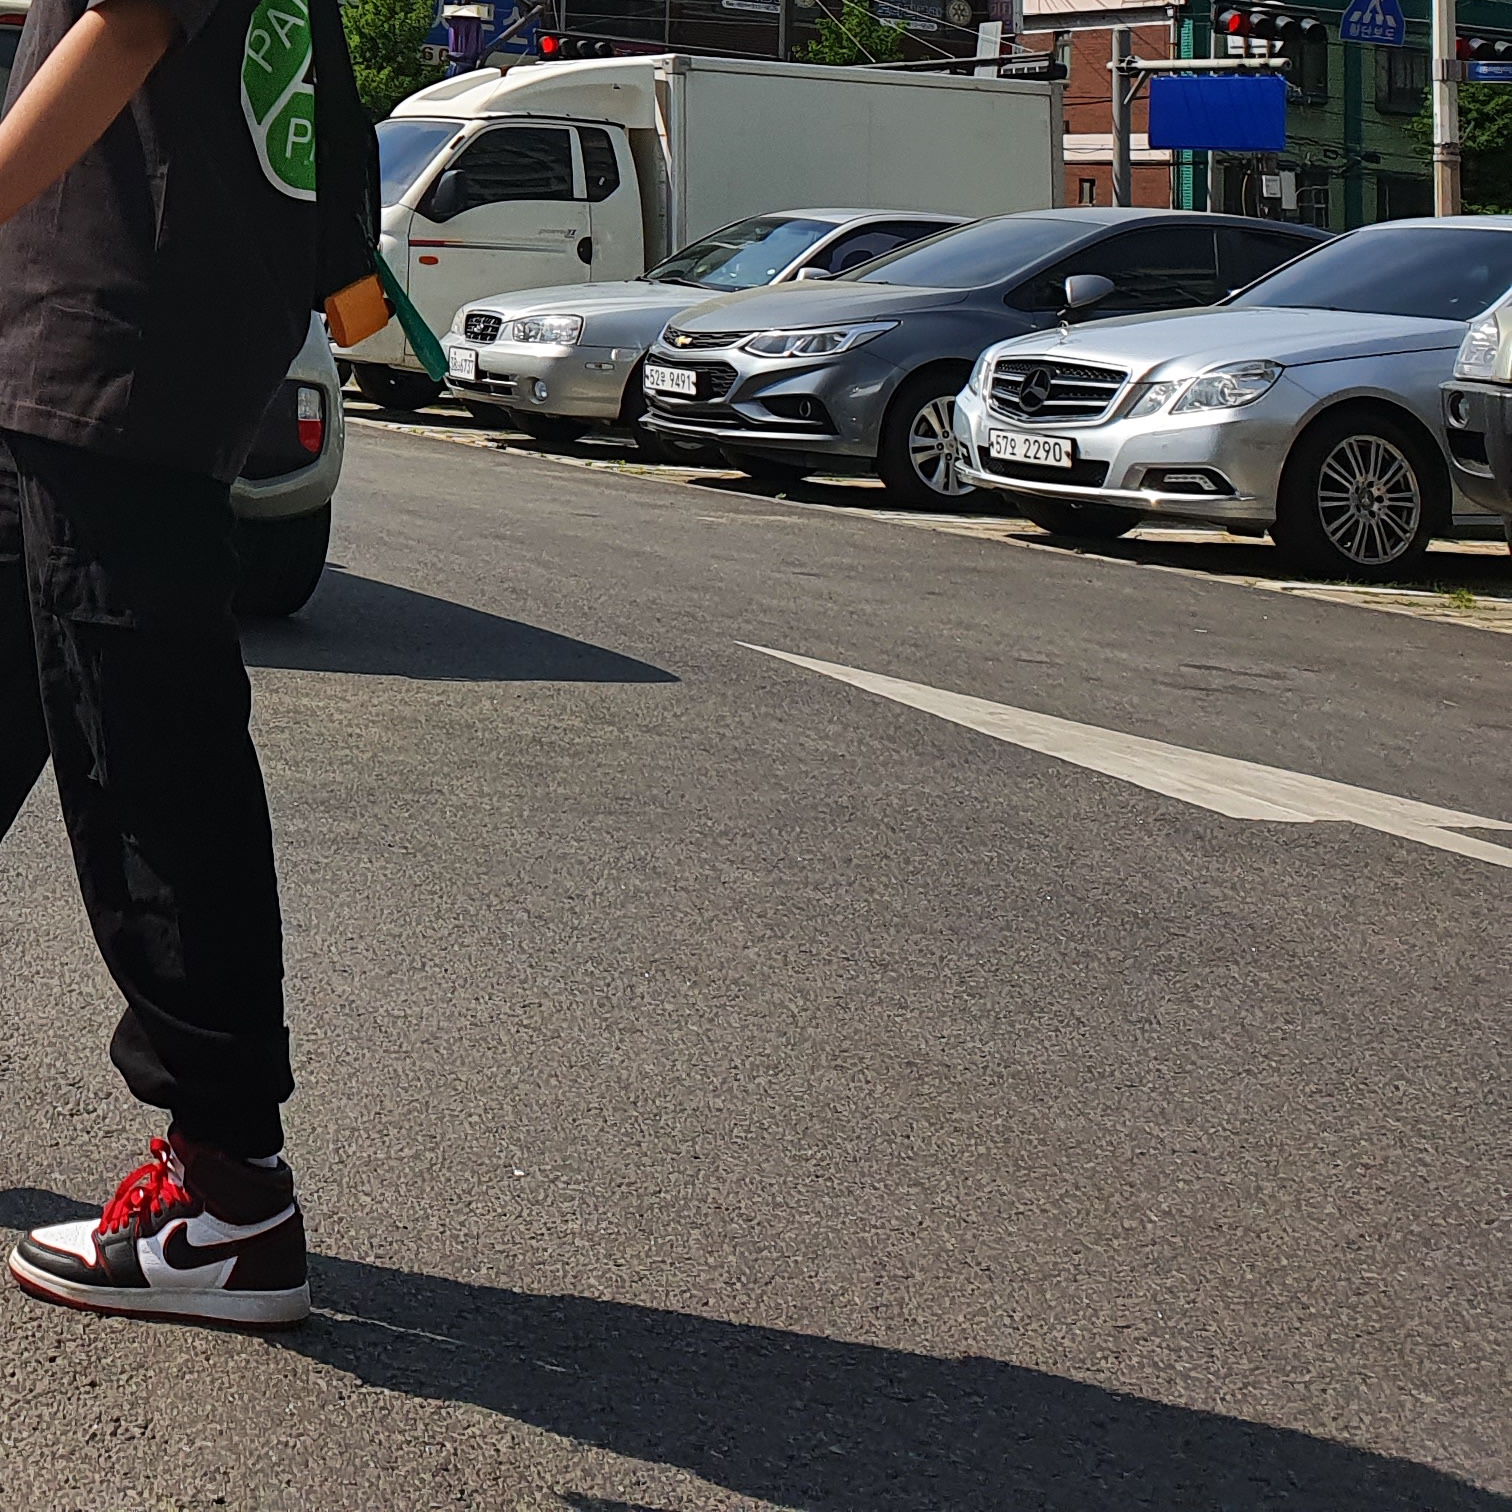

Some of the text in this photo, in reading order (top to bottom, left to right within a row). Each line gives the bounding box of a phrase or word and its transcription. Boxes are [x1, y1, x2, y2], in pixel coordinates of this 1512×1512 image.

[669, 371, 691, 392] 9491
[995, 434, 1062, 463] 57오 2290
